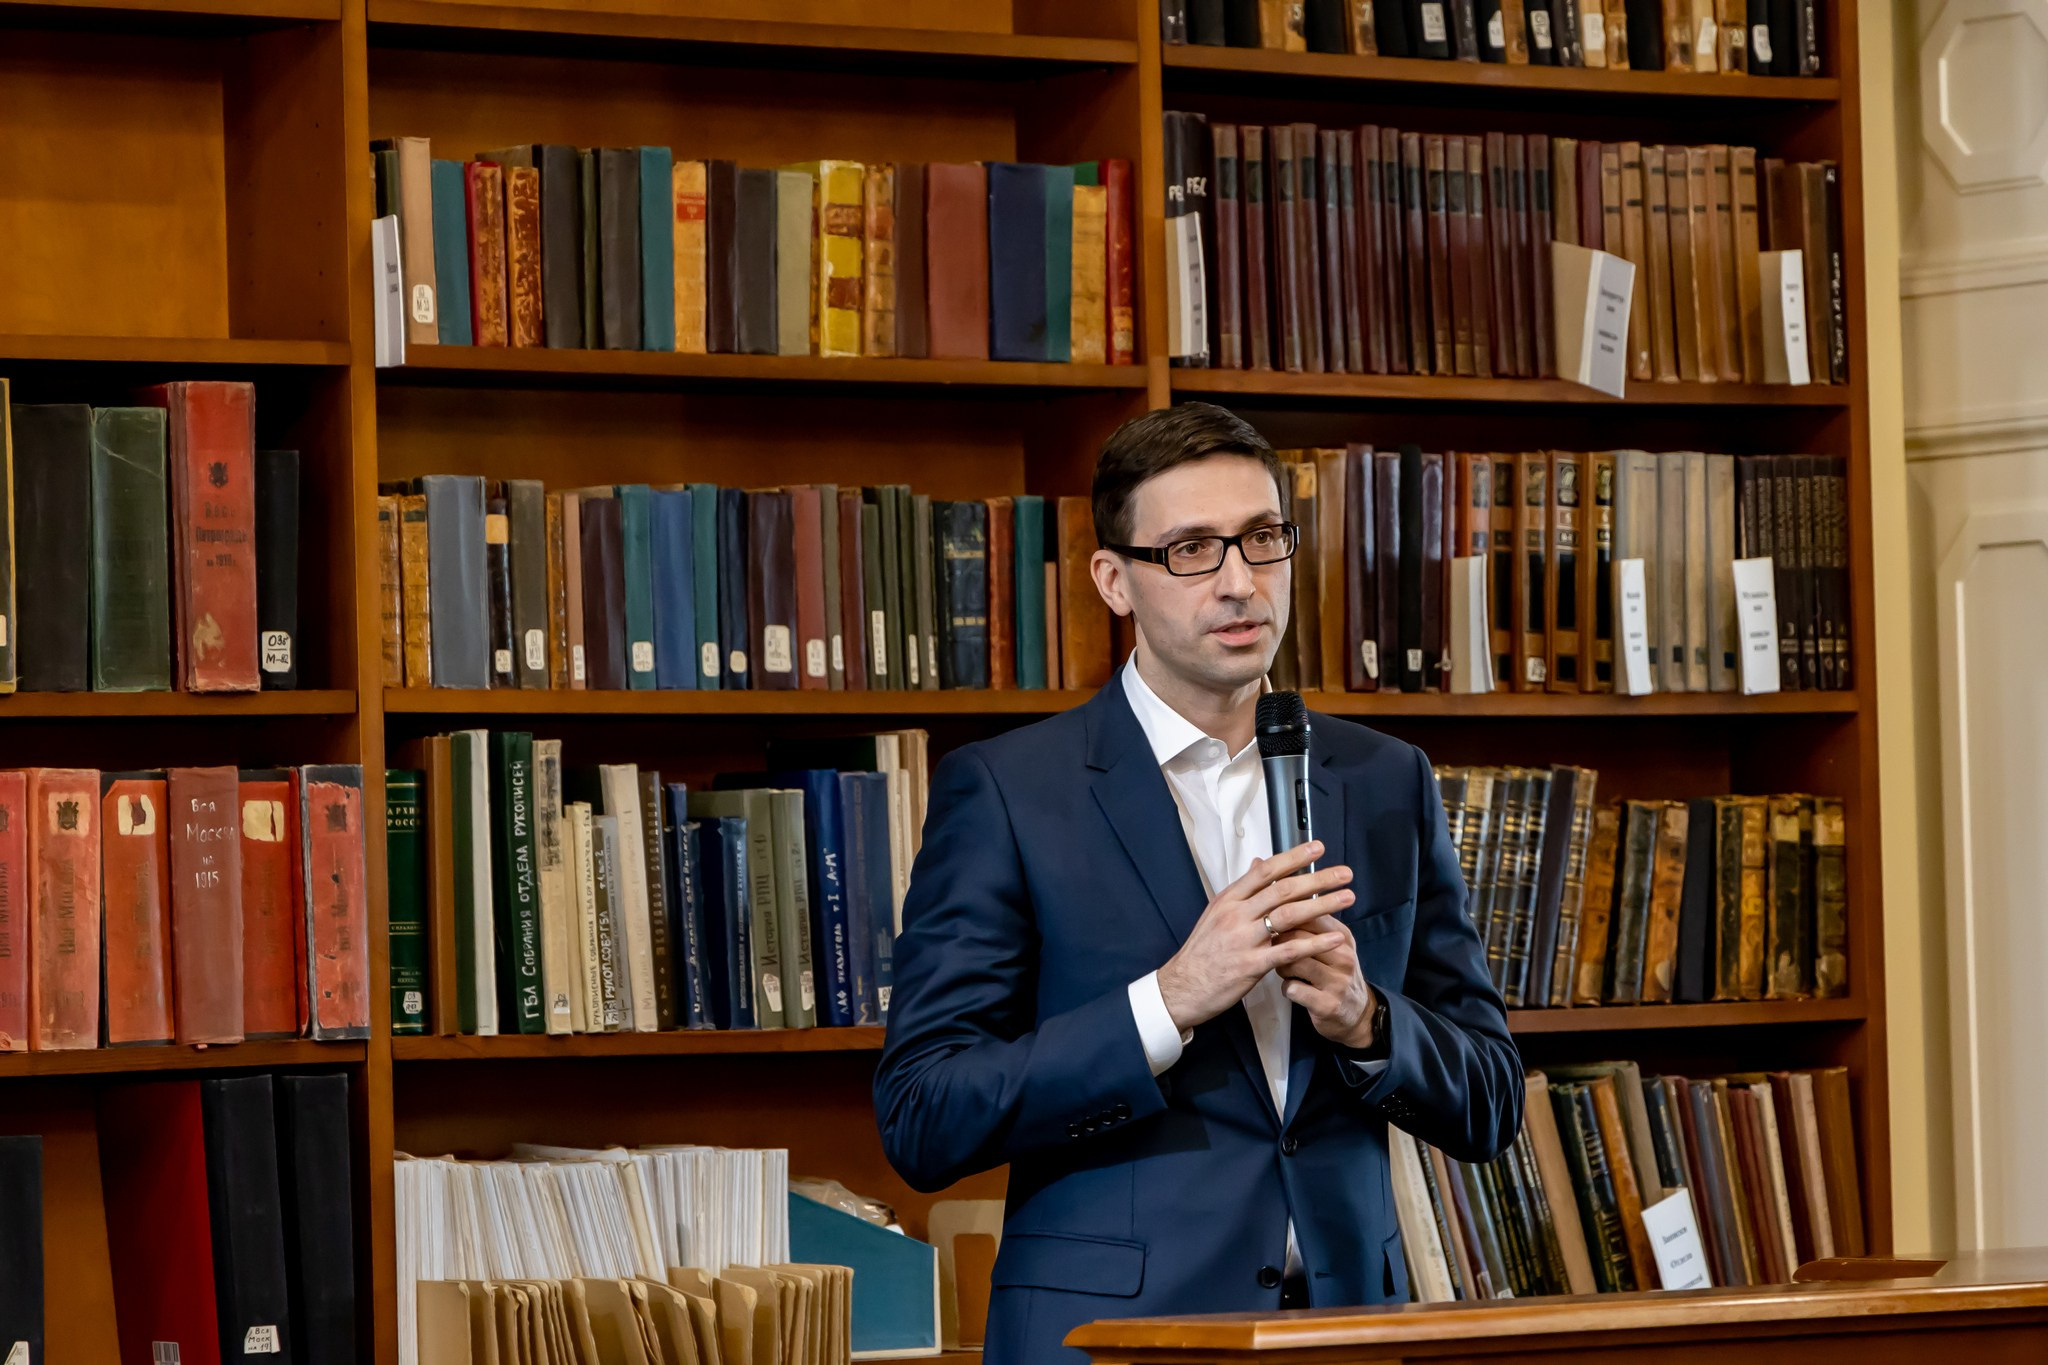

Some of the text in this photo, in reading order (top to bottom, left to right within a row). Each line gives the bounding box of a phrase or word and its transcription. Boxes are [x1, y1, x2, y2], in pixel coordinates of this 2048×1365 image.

[510, 760, 527, 837] РУКОПИСЕЙ
[185, 823, 235, 843] Москва
[194, 870, 219, 889] 1915
[516, 845, 534, 903] ОТДЕЛА
[834, 923, 846, 983] УКАЗАТЕЛЬ
[523, 986, 540, 1018] ГБЛ
